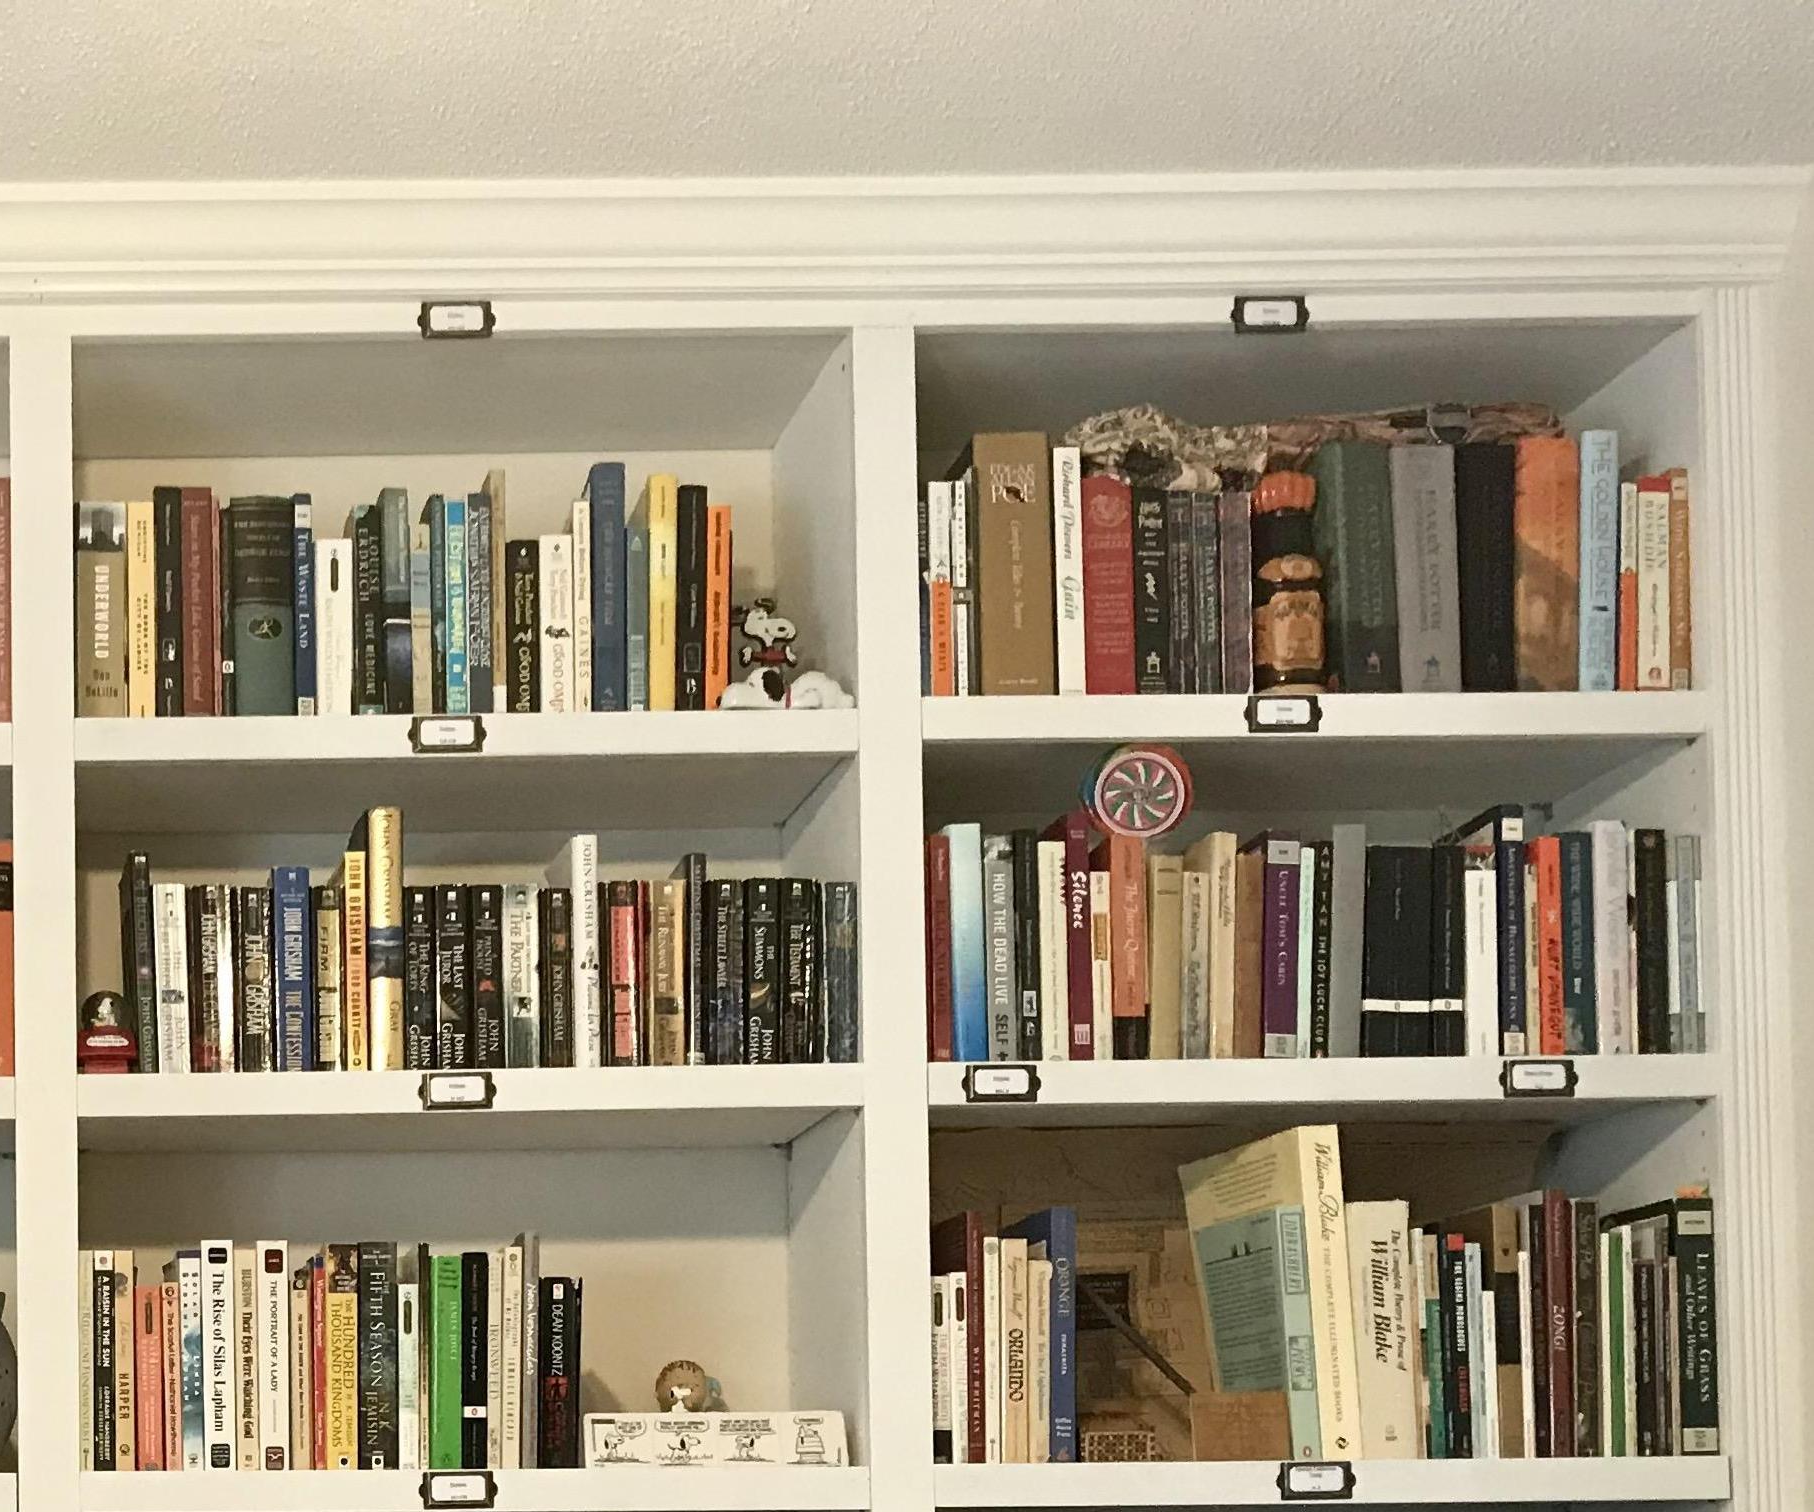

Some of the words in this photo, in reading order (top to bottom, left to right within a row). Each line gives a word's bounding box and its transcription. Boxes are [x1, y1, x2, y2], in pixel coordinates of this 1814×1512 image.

[1592, 439, 1612, 474] THE
[1061, 460, 1074, 508] Richard
[1595, 478, 1612, 540] GOLDEN
[298, 534, 309, 557] THE
[1061, 512, 1075, 560] Powers
[359, 528, 370, 602] ERDRICH
[369, 536, 379, 594] LOUISE
[1594, 546, 1611, 599] HOUSE
[298, 564, 309, 606] WASTE
[1062, 576, 1080, 620] Gain
[94, 565, 110, 658] UNDERWORLD
[365, 613, 375, 639] LOVE
[298, 613, 310, 649] LAND
[579, 616, 589, 679] GAINES
[365, 644, 375, 696] MEDICINE
[582, 841, 593, 877] JOHN
[992, 873, 1006, 904] HOW
[1070, 871, 1086, 929] Silence
[284, 907, 302, 931] JOHN
[510, 912, 523, 937] THE
[584, 880, 594, 939] GRISHAM
[993, 908, 1006, 933] THE
[284, 934, 302, 981] GRISHAM
[442, 950, 452, 984] JUROR
[453, 944, 464, 967] THE
[510, 942, 523, 993] PARTNER
[754, 926, 766, 980] SUMMONS
[994, 938, 1007, 972] DEAD
[454, 969, 464, 989] LAST
[995, 977, 1008, 1005] LIVE
[477, 1007, 488, 1061] GRISHAM
[489, 1019, 499, 1051] JOHN
[762, 1029, 774, 1059] JOHN
[995, 1014, 1009, 1045] SELF
[454, 1033, 465, 1064] JOHN
[102, 1276, 110, 1284] A
[212, 1270, 225, 1295] The
[270, 1280, 278, 1299] THE
[1370, 1240, 1391, 1308] William
[102, 1286, 110, 1315] RAISIN
[212, 1299, 225, 1325] Rise
[369, 1272, 385, 1316] FIFTH
[102, 1317, 110, 1327] IN
[213, 1328, 226, 1343] of
[270, 1300, 278, 1346] PORTRAIT
[552, 1304, 562, 1332] DEAN
[102, 1329, 110, 1346] THE
[270, 1347, 278, 1360] OF
[331, 1302, 342, 1374] THOUSAND
[342, 1316, 355, 1389] HUNDRED
[370, 1321, 385, 1387] SEASON
[552, 1335, 563, 1376] KOONTZ
[1374, 1313, 1392, 1363] Blake
[102, 1349, 110, 1367] SUN
[213, 1345, 226, 1377] Silas
[1008, 1328, 1024, 1402] ORLANDO
[118, 1373, 130, 1420] HARPER
[270, 1369, 278, 1392] LADY
[211, 1381, 226, 1432] Lapham
[331, 1378, 343, 1448] KINGDOMS
[365, 1391, 379, 1445] JEMISIN
